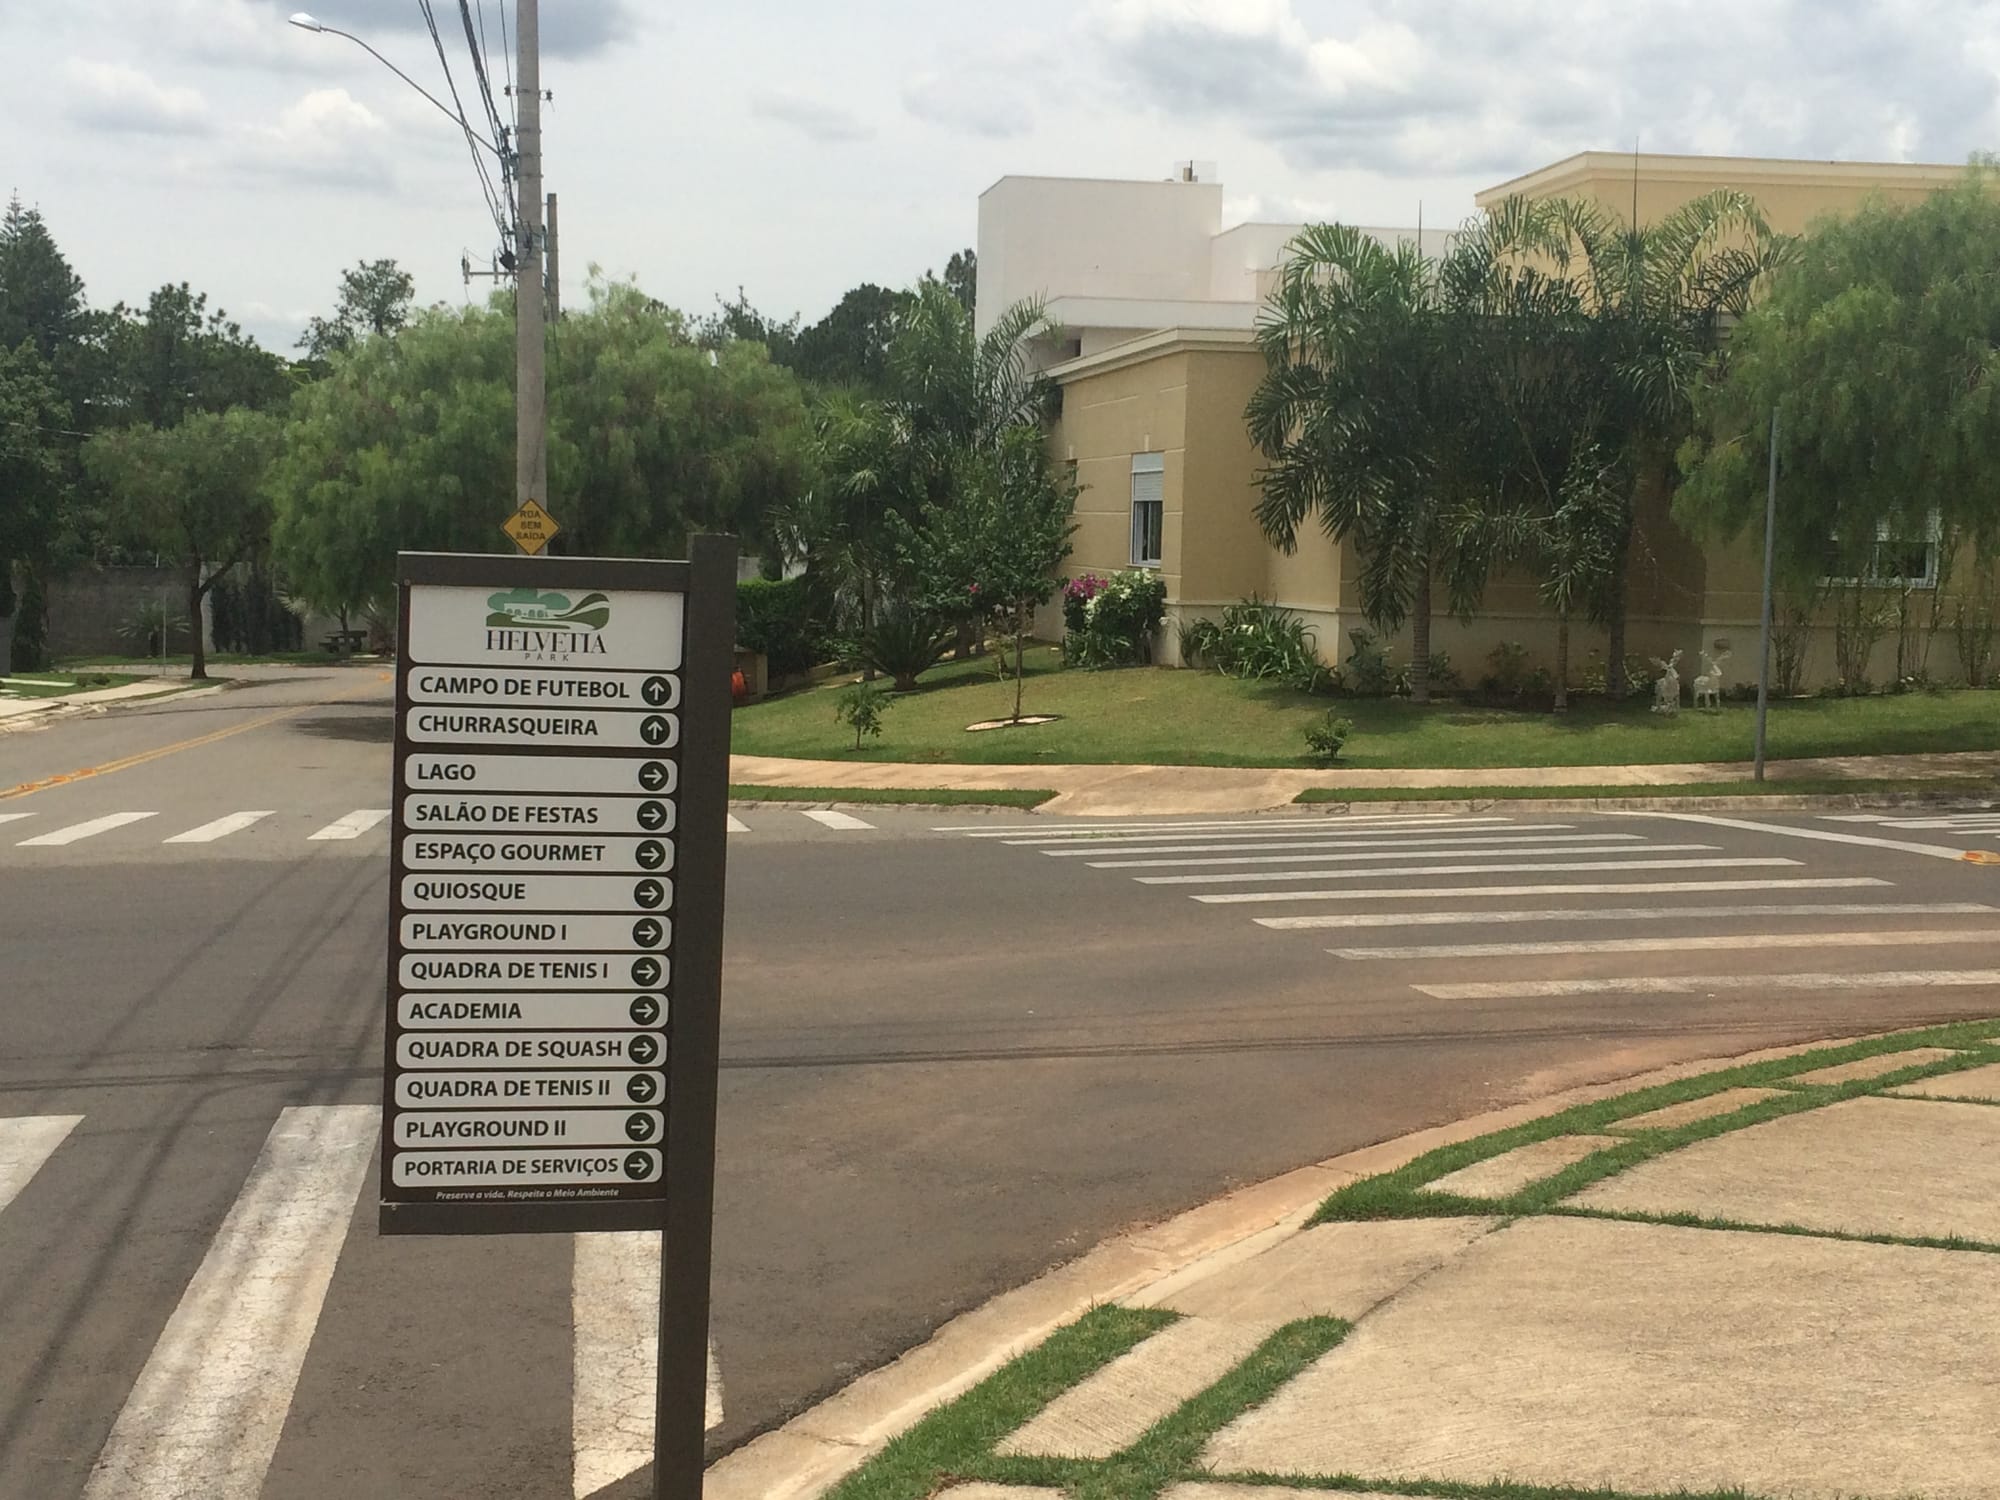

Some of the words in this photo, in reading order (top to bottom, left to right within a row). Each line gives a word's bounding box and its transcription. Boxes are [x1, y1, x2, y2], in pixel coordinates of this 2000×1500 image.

[521, 521, 541, 529] SEM
[486, 630, 607, 654] HELVETIA
[525, 654, 570, 662] PARK
[420, 676, 498, 694] CAMPO
[505, 679, 530, 695] DE
[537, 680, 630, 698] FUTEBOL
[418, 715, 598, 737] CHURRASQUEIRA
[418, 764, 476, 781] LAGO
[416, 801, 486, 822] SALÃO
[493, 806, 519, 822] DE
[526, 807, 598, 824] FESTAS
[415, 843, 495, 864] ESPAÇO
[501, 844, 605, 861] GOURMET
[413, 883, 525, 901] QUIOSQUE
[412, 924, 556, 940] PLAYGROUND
[561, 924, 566, 940] I
[411, 963, 502, 981] QUADRA
[508, 963, 534, 978] DE
[540, 963, 597, 979] TENIS
[602, 963, 608, 978] I
[409, 1003, 522, 1019] ACADEMIA
[408, 1041, 499, 1060] QUADRA
[505, 1042, 532, 1057] DE
[538, 1040, 622, 1059] SQUASH
[407, 1081, 497, 1099] QUADRA
[504, 1081, 530, 1096] DE
[536, 1080, 594, 1096] TENIS
[599, 1080, 610, 1095] II
[406, 1121, 549, 1138] PLAYGROUND
[554, 1121, 566, 1136] II
[405, 1160, 497, 1176] PORTARIA
[502, 1160, 526, 1174] DE
[531, 1158, 619, 1177] SERVIÇOS
[436, 1191, 475, 1199] Preserve
[508, 1190, 545, 1199] Respeite
[554, 1189, 575, 1197] Meio
[577, 1188, 619, 1197] Ambiente
